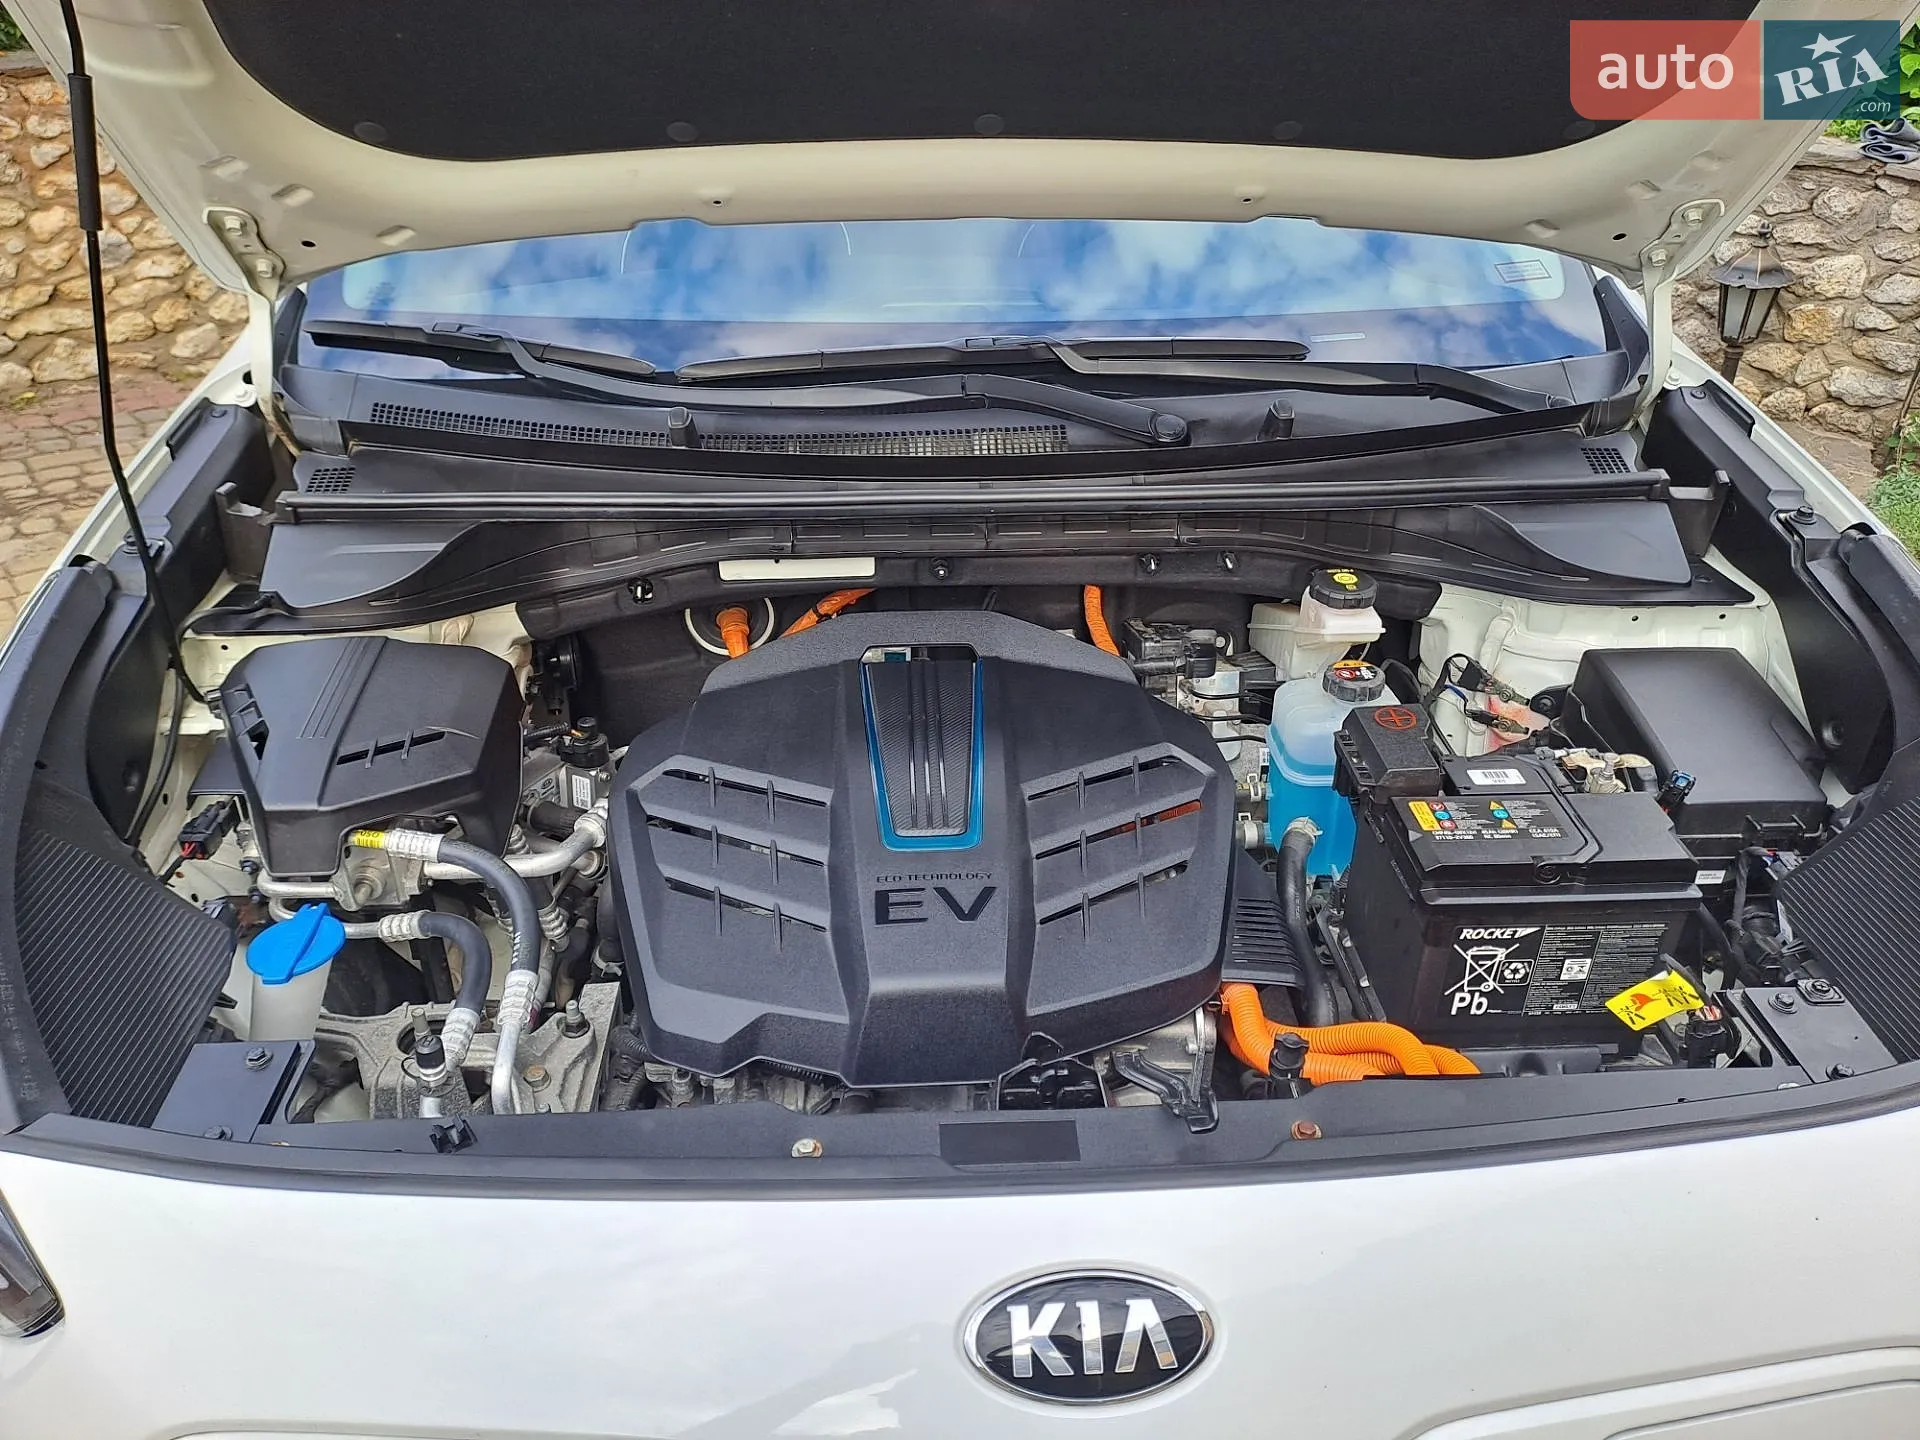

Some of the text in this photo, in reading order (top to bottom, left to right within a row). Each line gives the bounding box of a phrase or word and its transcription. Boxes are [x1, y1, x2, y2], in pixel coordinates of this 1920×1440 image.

[876, 872, 993, 884] ECO TECHNOLOGY
[875, 886, 997, 926] EV
[1459, 928, 1522, 940] ROCKET
[1450, 992, 1488, 1015] Pb
[1006, 1298, 1178, 1377] KIA
